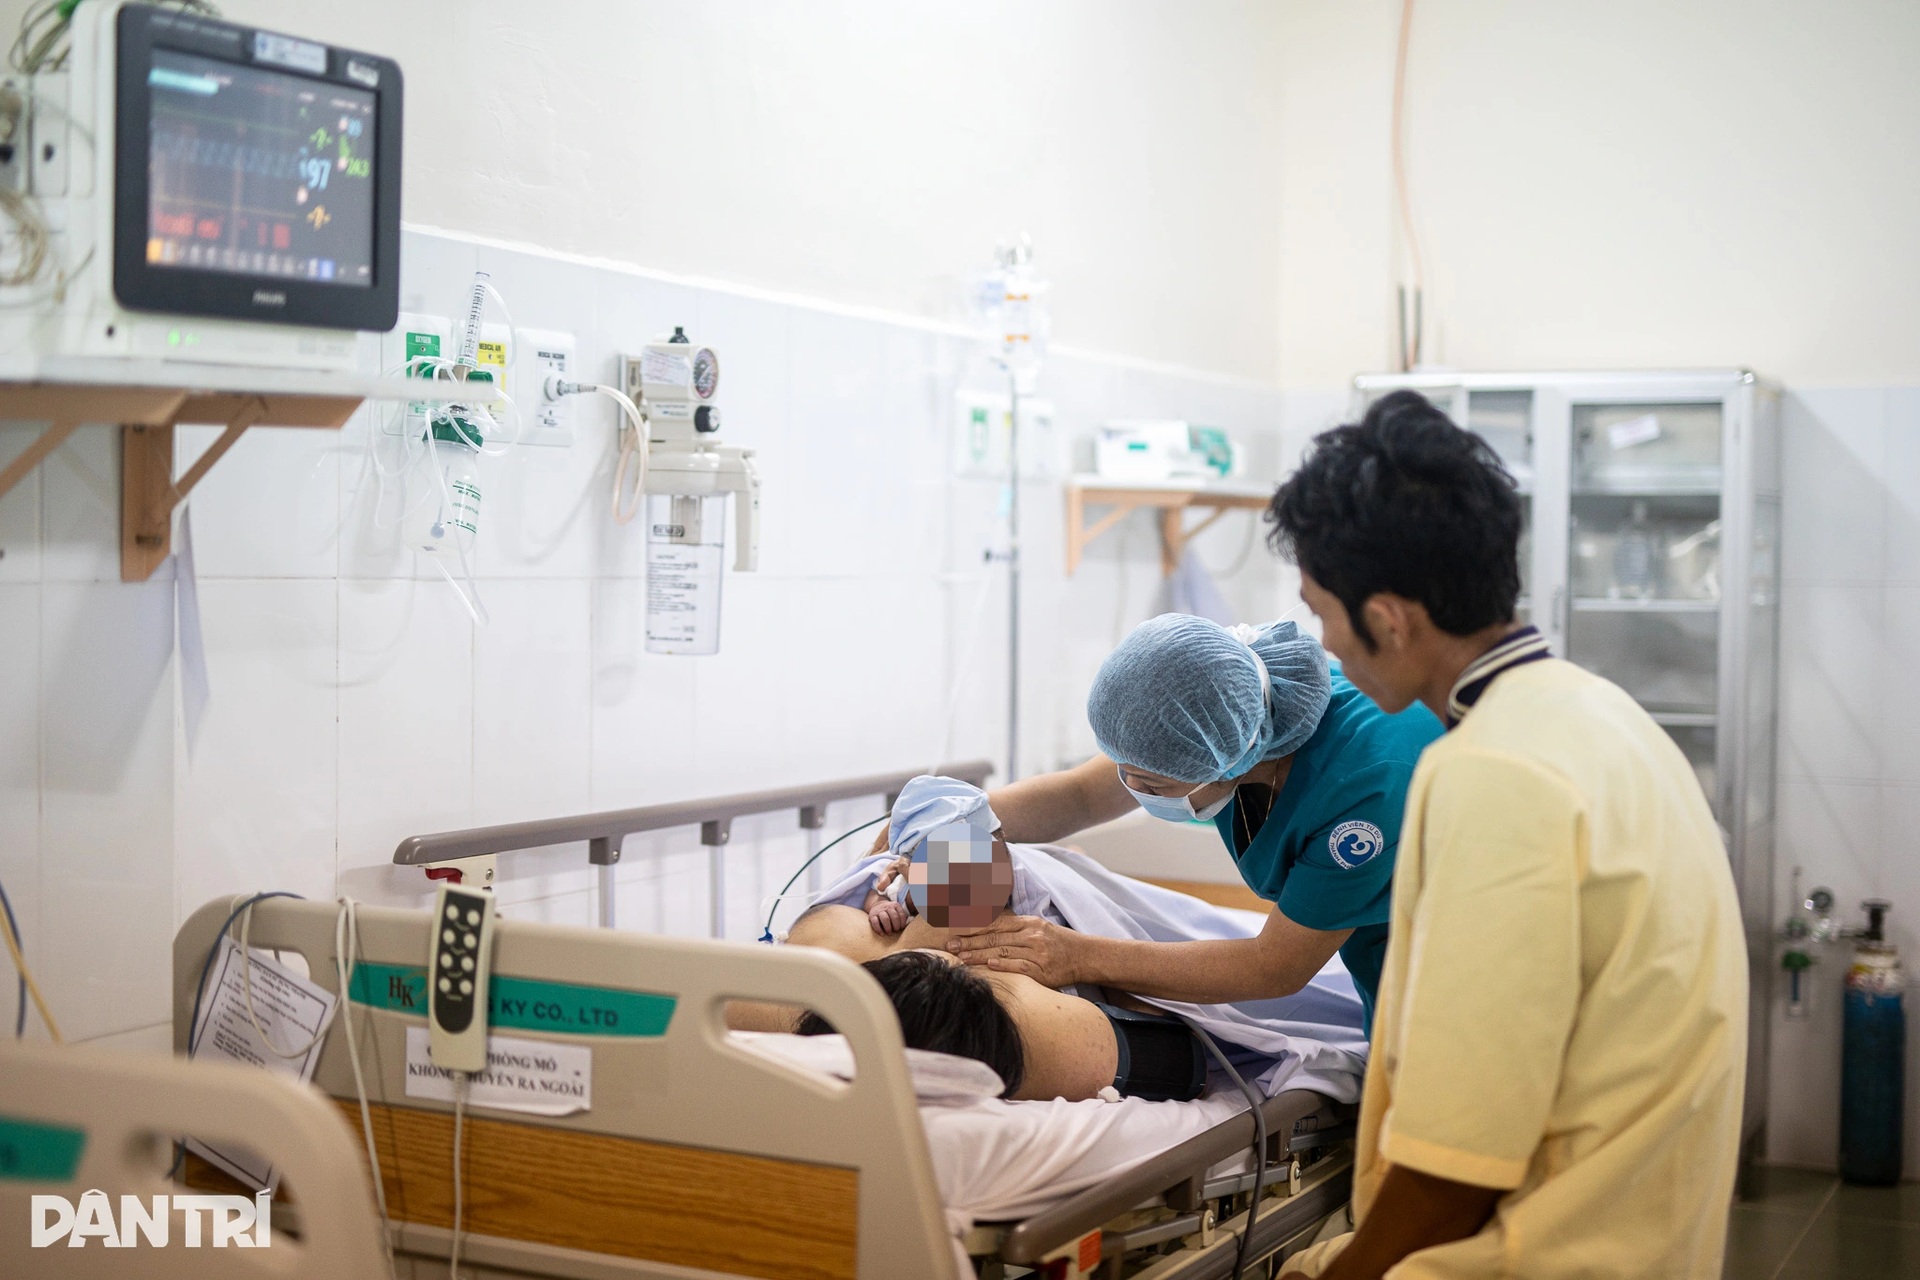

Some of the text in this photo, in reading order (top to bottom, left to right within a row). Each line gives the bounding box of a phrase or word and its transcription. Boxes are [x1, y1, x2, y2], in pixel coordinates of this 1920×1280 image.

[479, 342, 494, 351] MEDICAL
[501, 1000, 528, 1017] KY
[579, 1007, 619, 1027] LTD
[517, 1076, 536, 1091] RA
